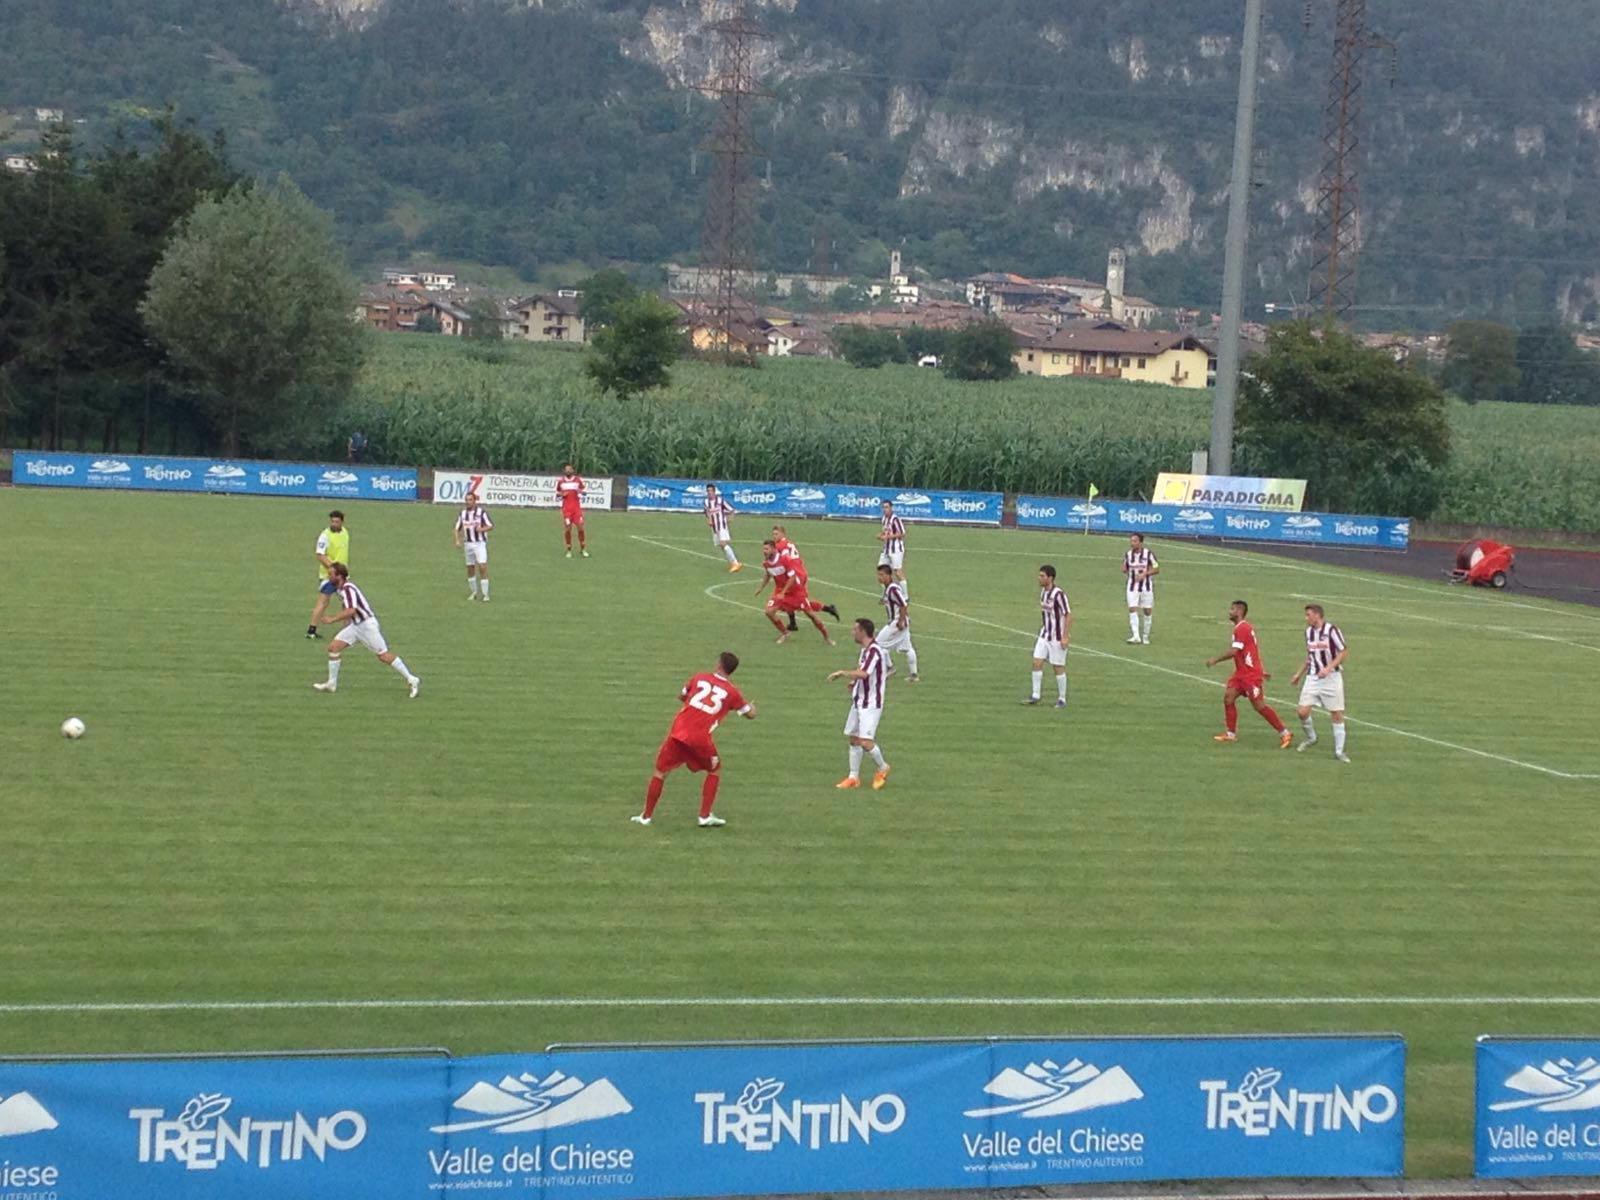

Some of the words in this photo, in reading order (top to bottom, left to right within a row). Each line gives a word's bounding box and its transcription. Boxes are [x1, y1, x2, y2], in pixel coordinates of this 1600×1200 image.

[26, 461, 75, 476] TRENTINO
[143, 465, 192, 481] TRENTINO
[259, 471, 305, 487] TRENTINO
[371, 476, 416, 491] TRENTINO
[489, 476, 539, 489] TORNERIA
[486, 492, 517, 501] STORO
[733, 489, 776, 504] TRENTINO
[837, 494, 881, 508] TRENTINO
[1191, 489, 1295, 506] PARADIGMA
[942, 498, 987, 513] TRENTINO
[1016, 504, 1056, 518] RENTINO
[1119, 509, 1163, 524] TRENTINO
[1226, 515, 1271, 530] TRENTINO
[1335, 521, 1379, 537] TRENTINO
[689, 680, 728, 715] 23
[1199, 1079, 1398, 1137] TRENTINO
[694, 1092, 906, 1151] TRENTINO
[128, 1107, 367, 1171] TRENTINO
[962, 1131, 1022, 1158] Valle
[1028, 1129, 1063, 1155] del
[1070, 1127, 1145, 1153] Chiese
[1488, 1124, 1538, 1150] Valle
[1544, 1122, 1577, 1147] del
[1583, 1123, 1600, 1147] C
[428, 1147, 494, 1175] Valle
[502, 1144, 542, 1173] del
[550, 1143, 635, 1171] Chiese
[1046, 1158, 1092, 1169] TRENTINO
[0, 1160, 59, 1187] iese
[524, 1175, 575, 1188] TRENTINO
